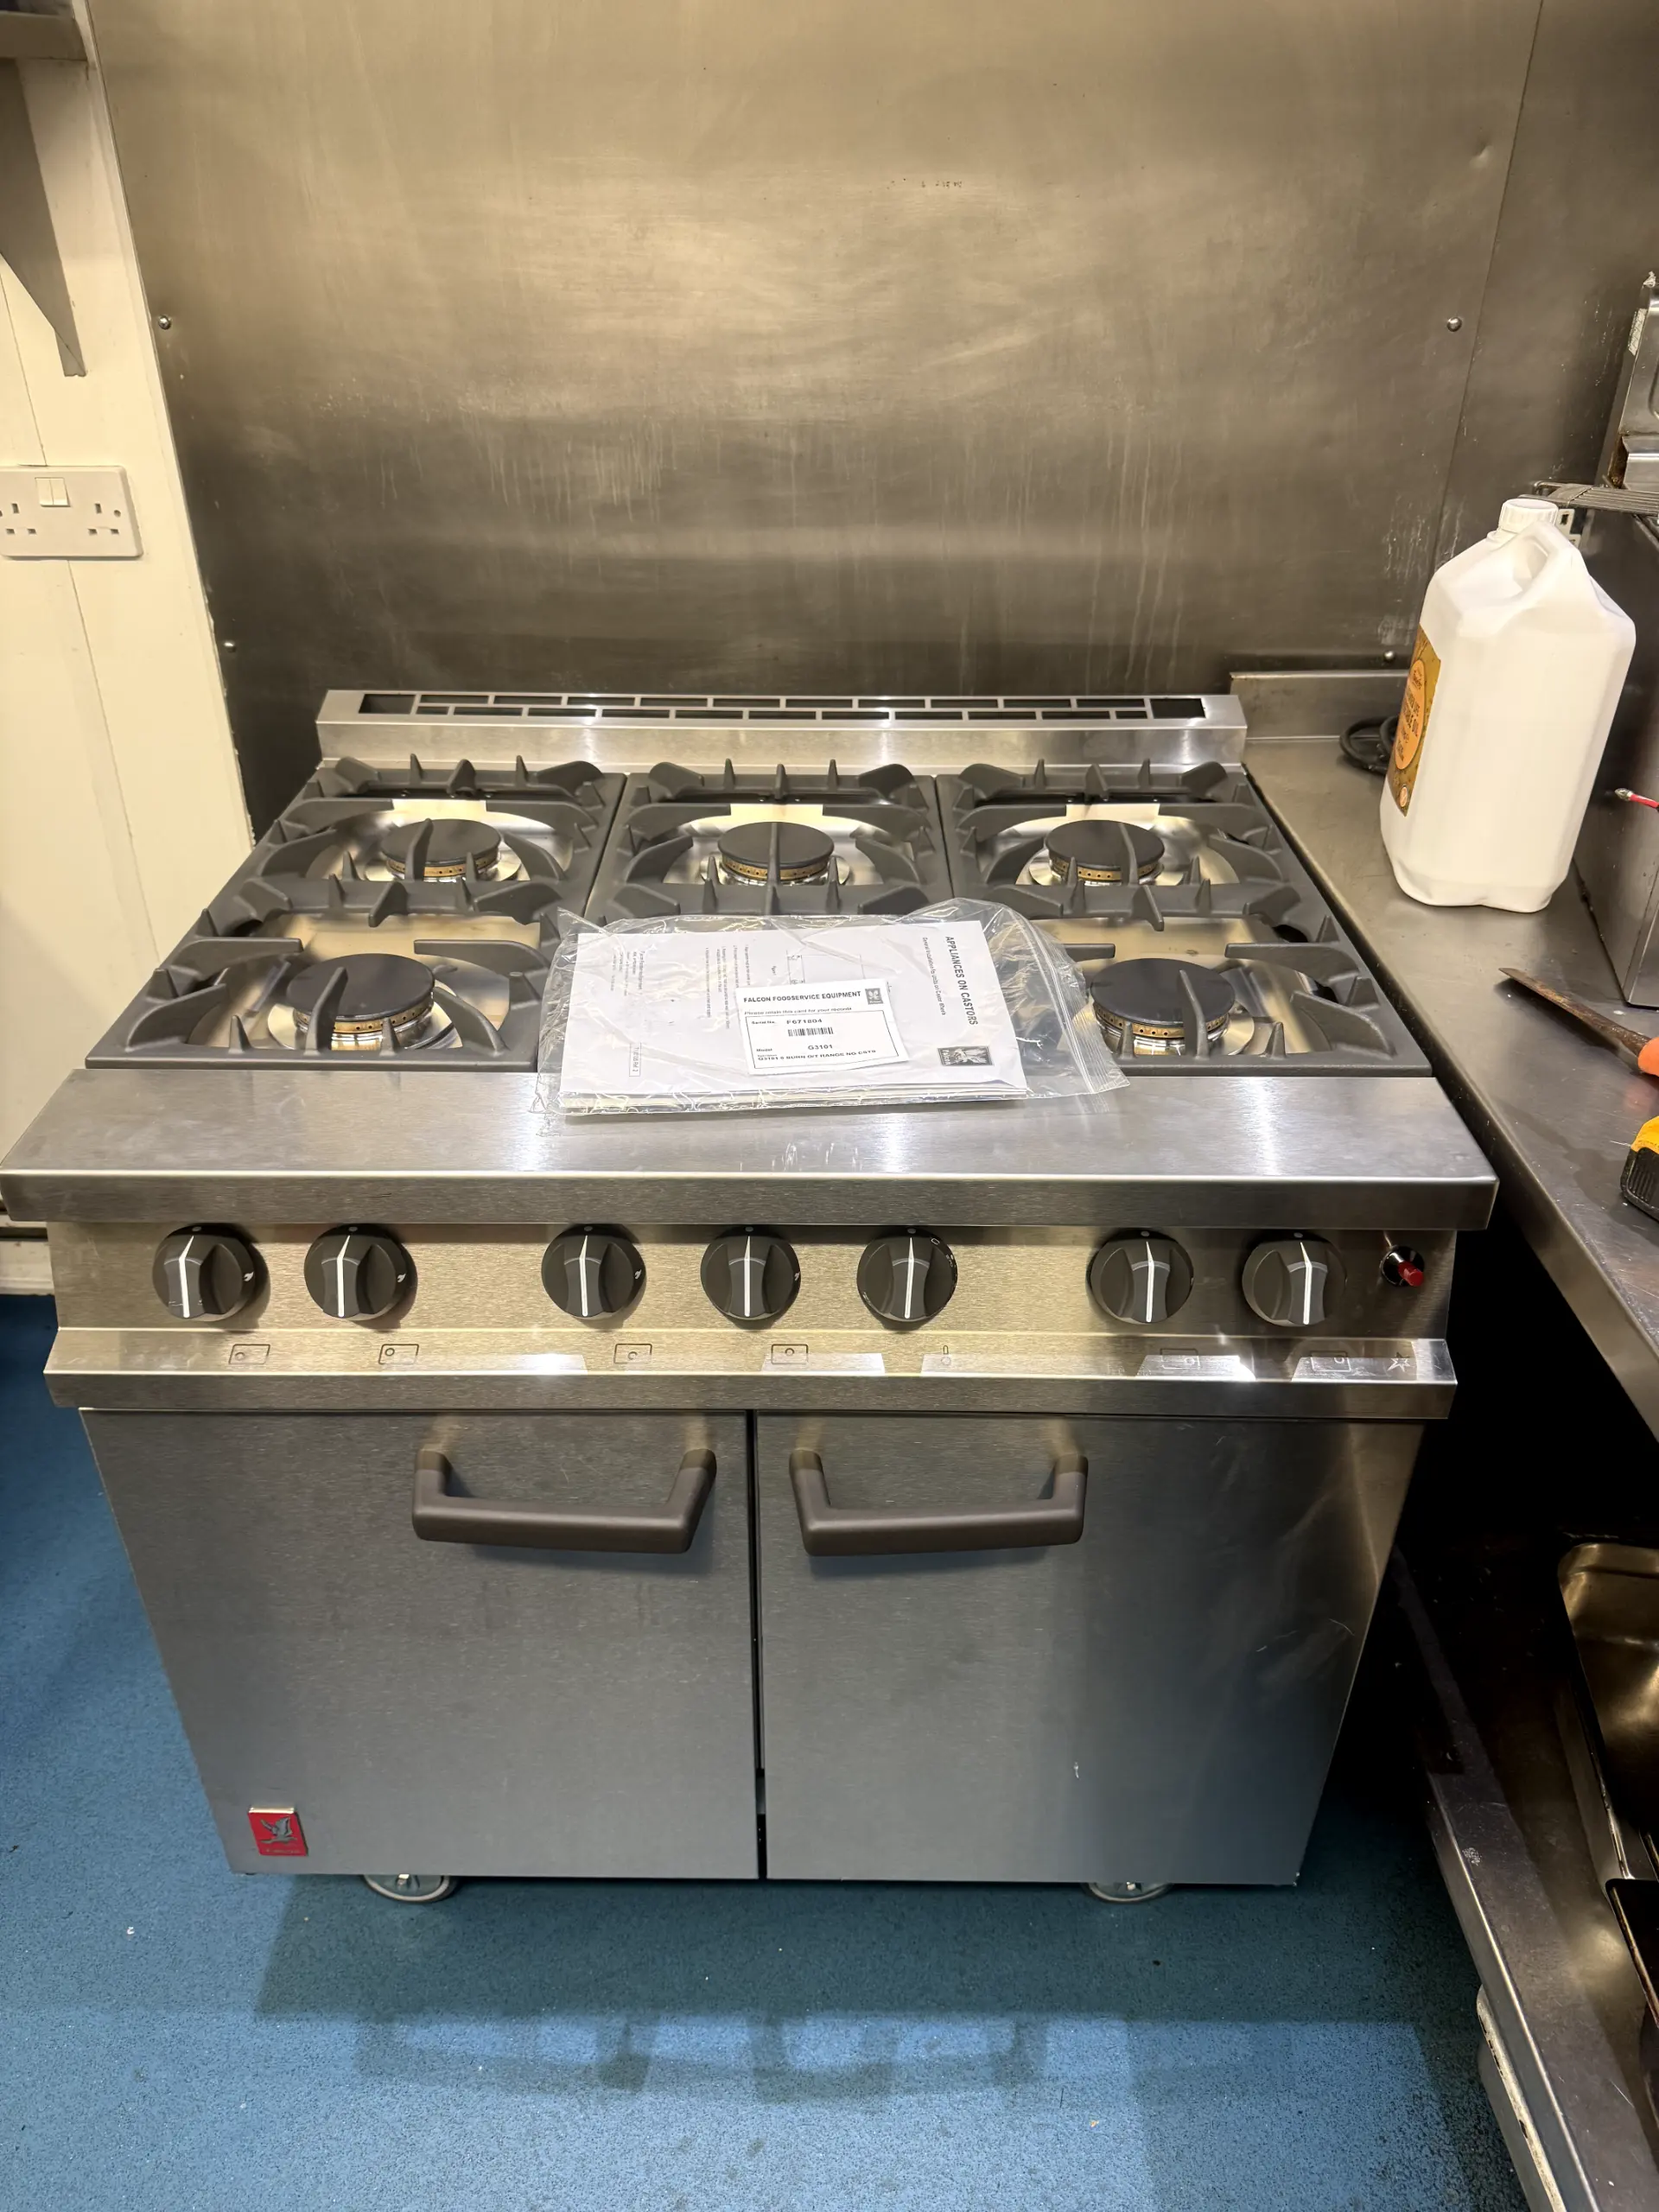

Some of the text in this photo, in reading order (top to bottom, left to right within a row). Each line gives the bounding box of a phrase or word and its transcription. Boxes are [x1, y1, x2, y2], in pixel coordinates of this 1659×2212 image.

[772, 993, 820, 1001] FOODSERVICE
[822, 990, 861, 999] EQUIPMENT
[945, 936, 978, 1026] APPLIANCES ON CASTORS
